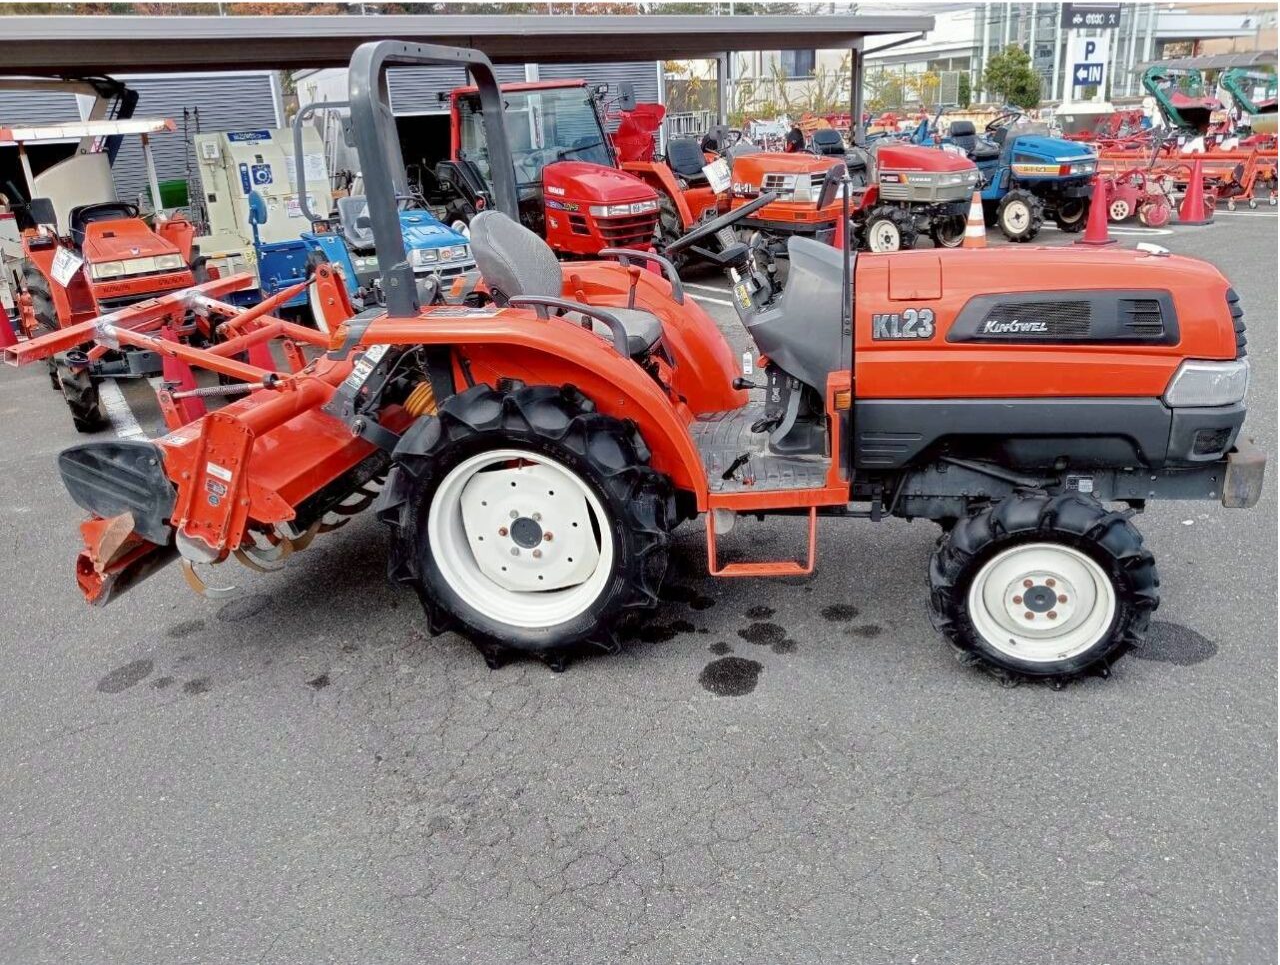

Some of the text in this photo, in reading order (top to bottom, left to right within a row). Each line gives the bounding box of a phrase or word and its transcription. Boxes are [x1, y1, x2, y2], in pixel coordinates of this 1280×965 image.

[1084, 41, 1096, 61] P
[1088, 65, 1101, 82] IN
[873, 308, 935, 338] KL23
